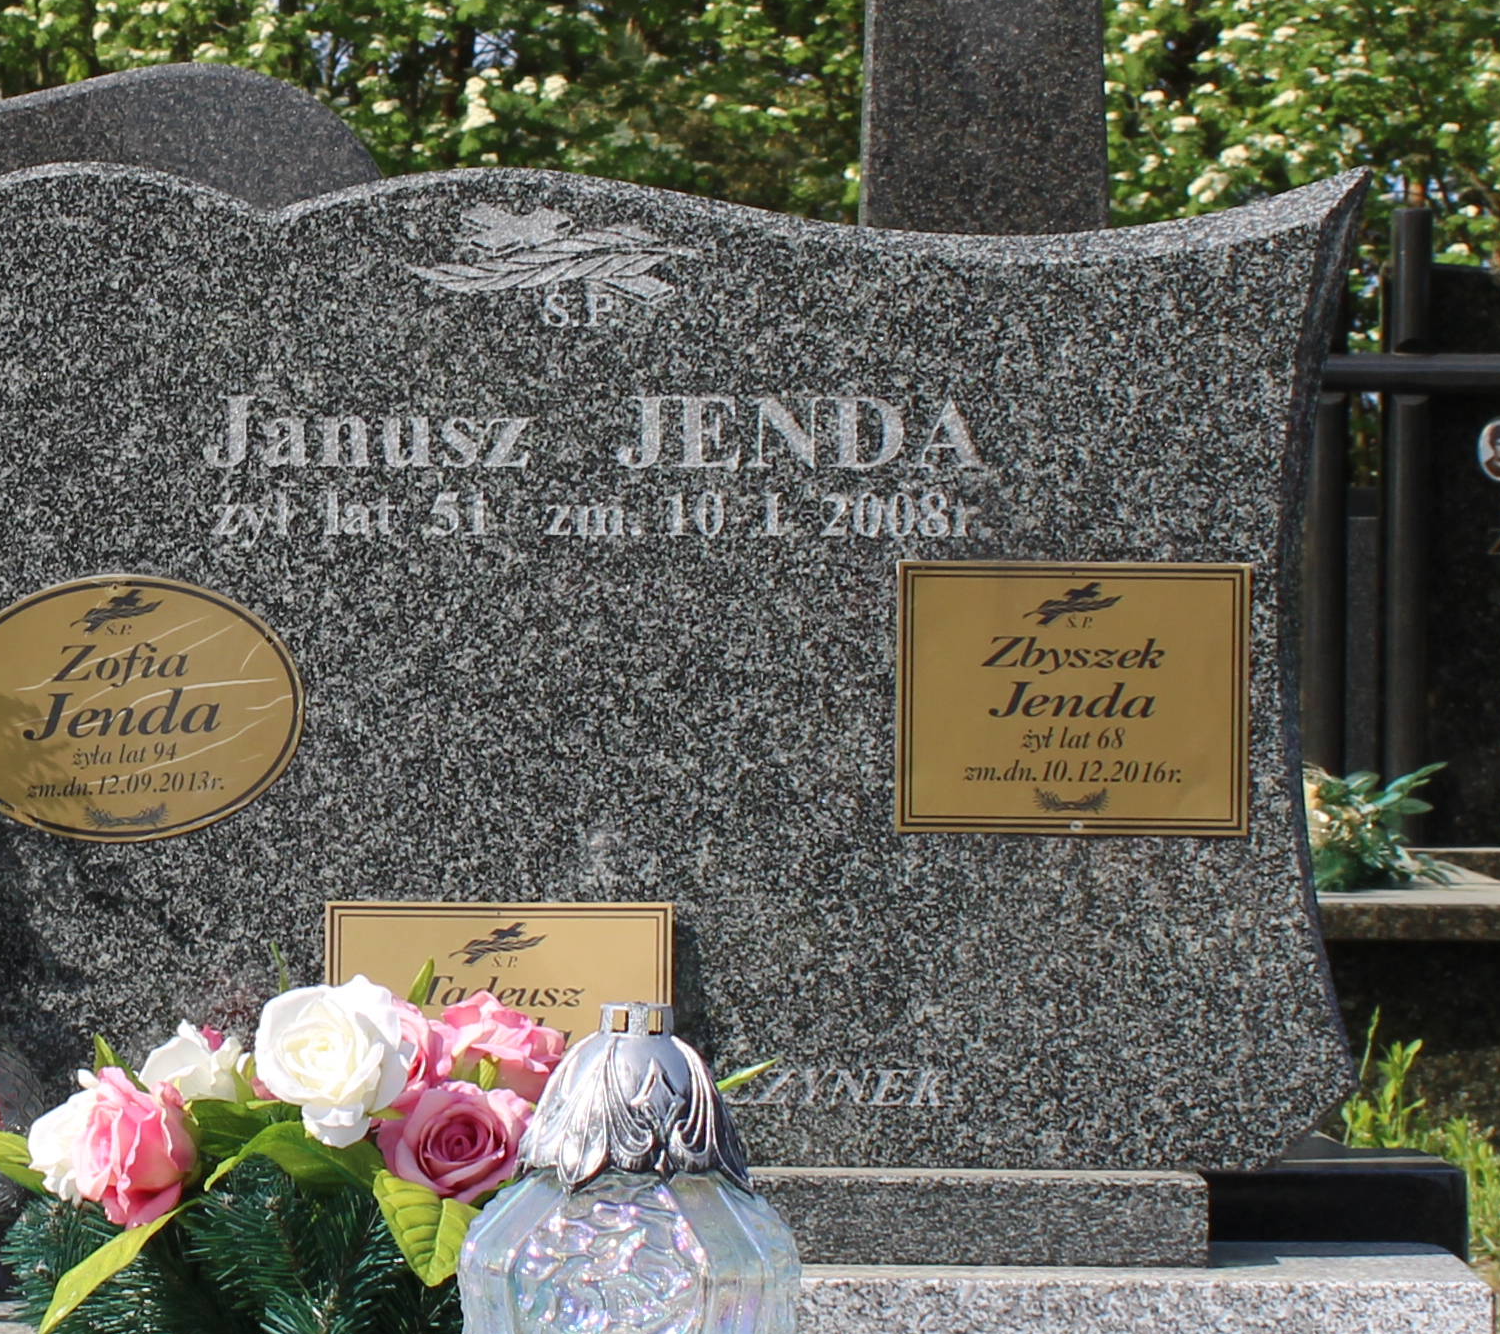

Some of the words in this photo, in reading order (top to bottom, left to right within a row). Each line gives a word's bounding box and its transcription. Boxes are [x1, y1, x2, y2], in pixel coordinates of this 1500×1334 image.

[203, 395, 531, 468] Janusz
[615, 395, 985, 468] JENDA
[324, 490, 396, 536] lat
[429, 490, 488, 536] 51
[544, 501, 643, 536] zm.
[666, 491, 726, 537] 10
[52, 641, 189, 687] Zofia
[981, 636, 1166, 675] Zbyszek
[22, 687, 222, 742] Jenda
[988, 681, 1156, 718] Jenda
[72, 744, 113, 767] żyła
[119, 743, 148, 765] lat
[153, 742, 178, 763] 94
[1021, 726, 1054, 753] żył
[1059, 727, 1091, 750] lat
[1097, 727, 1126, 750] 68
